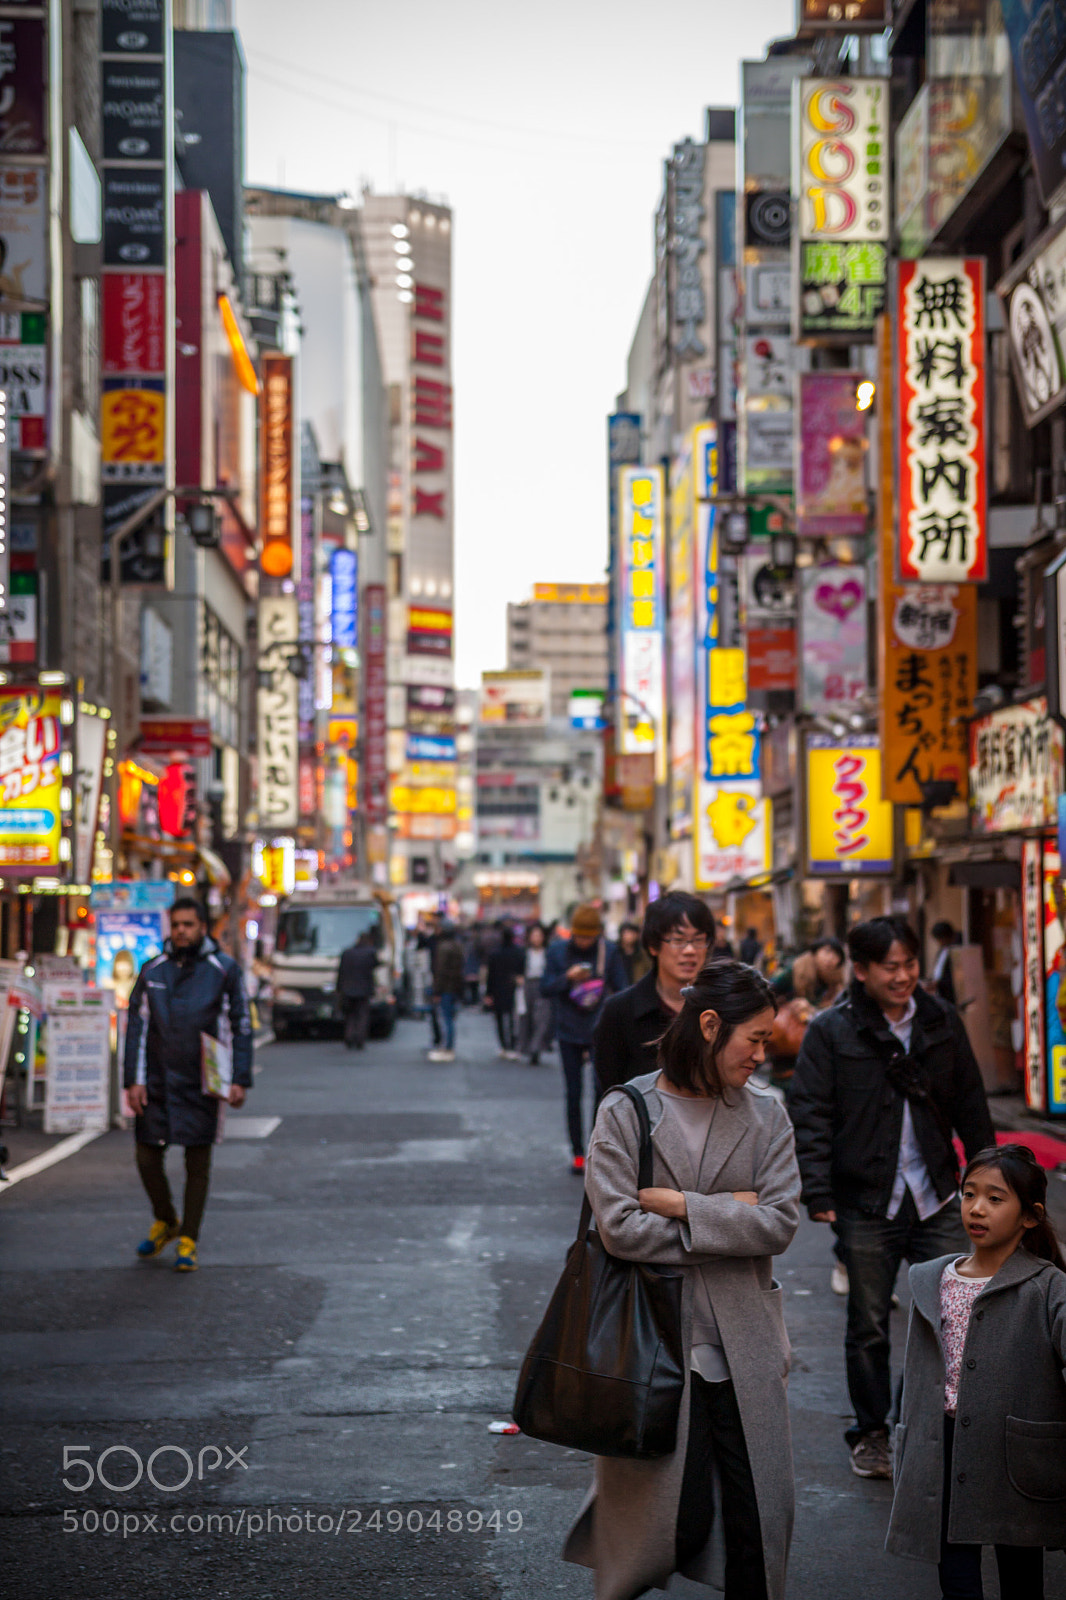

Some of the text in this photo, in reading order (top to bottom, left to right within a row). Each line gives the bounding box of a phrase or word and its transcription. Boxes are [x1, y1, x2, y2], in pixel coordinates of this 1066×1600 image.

[808, 84, 857, 235] GOD
[914, 276, 969, 562] 無料案内所
[834, 755, 867, 854] クラウン
